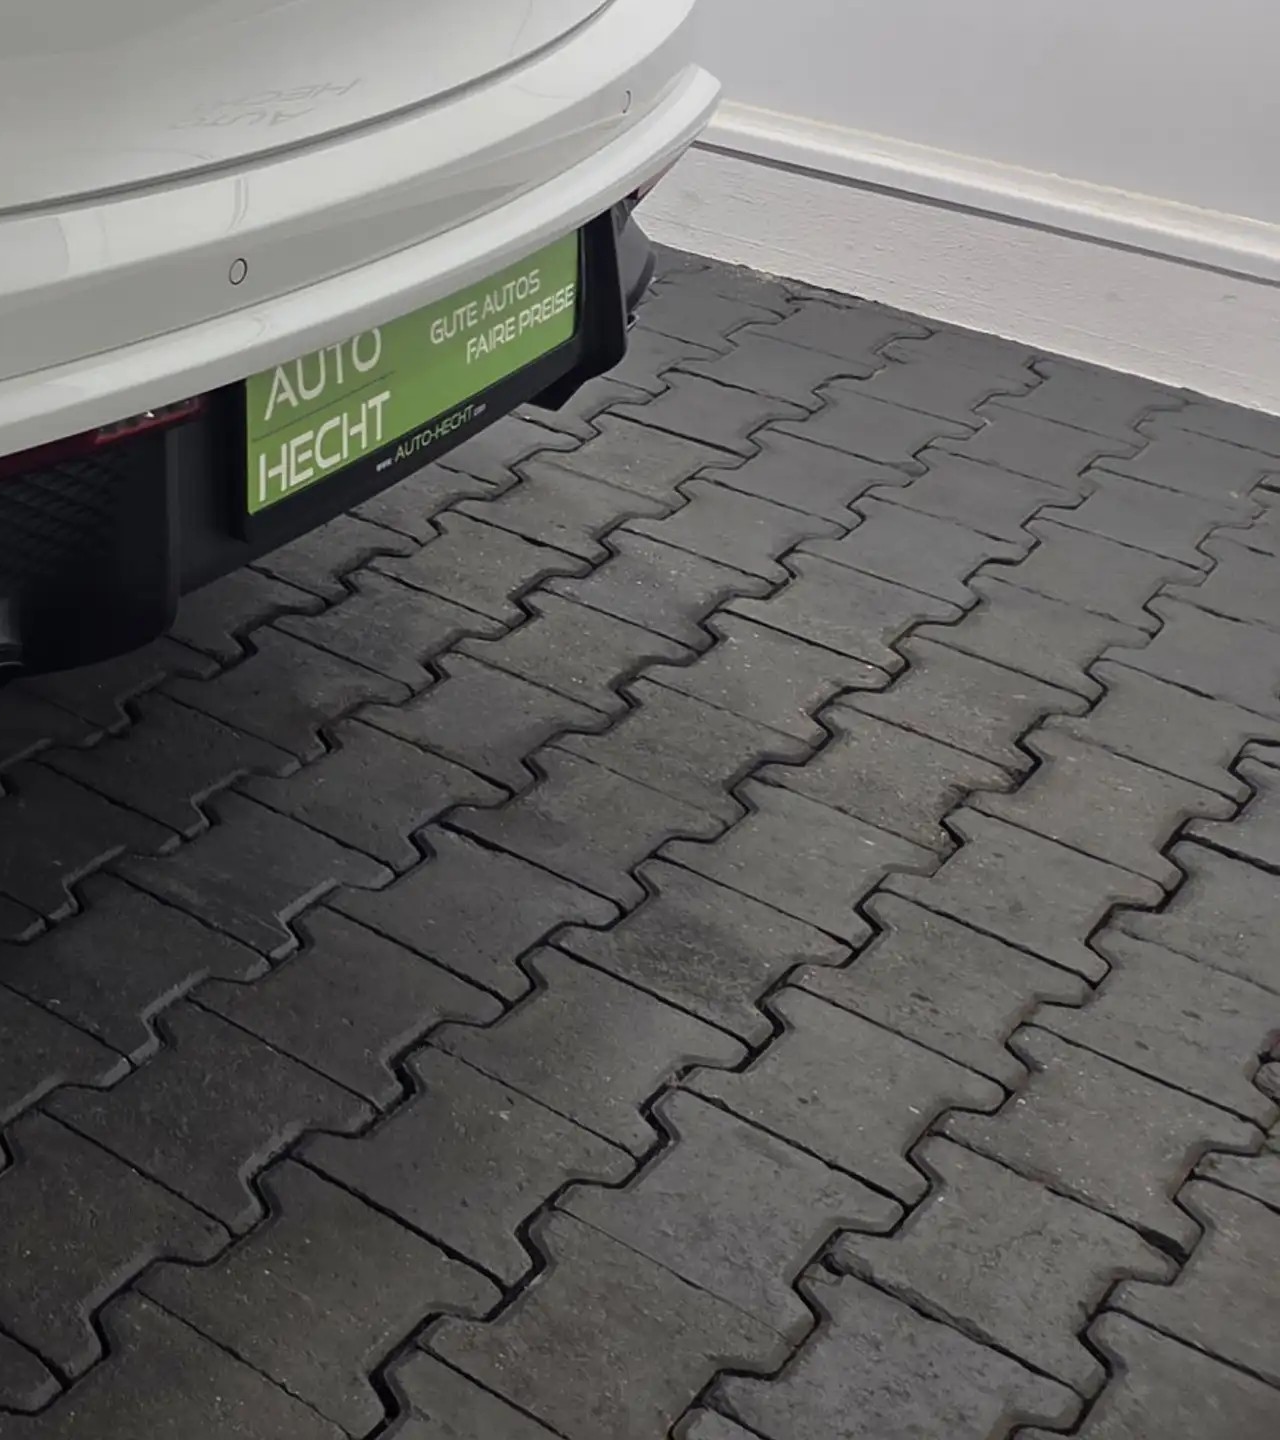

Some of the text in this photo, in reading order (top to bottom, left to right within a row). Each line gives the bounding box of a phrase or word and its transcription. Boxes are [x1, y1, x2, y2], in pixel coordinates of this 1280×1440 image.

[430, 269, 541, 345] GUTE AUTOS
[466, 283, 575, 365] FAIRE PREISE
[264, 328, 382, 421] AUTO
[259, 390, 391, 502] HECHT
